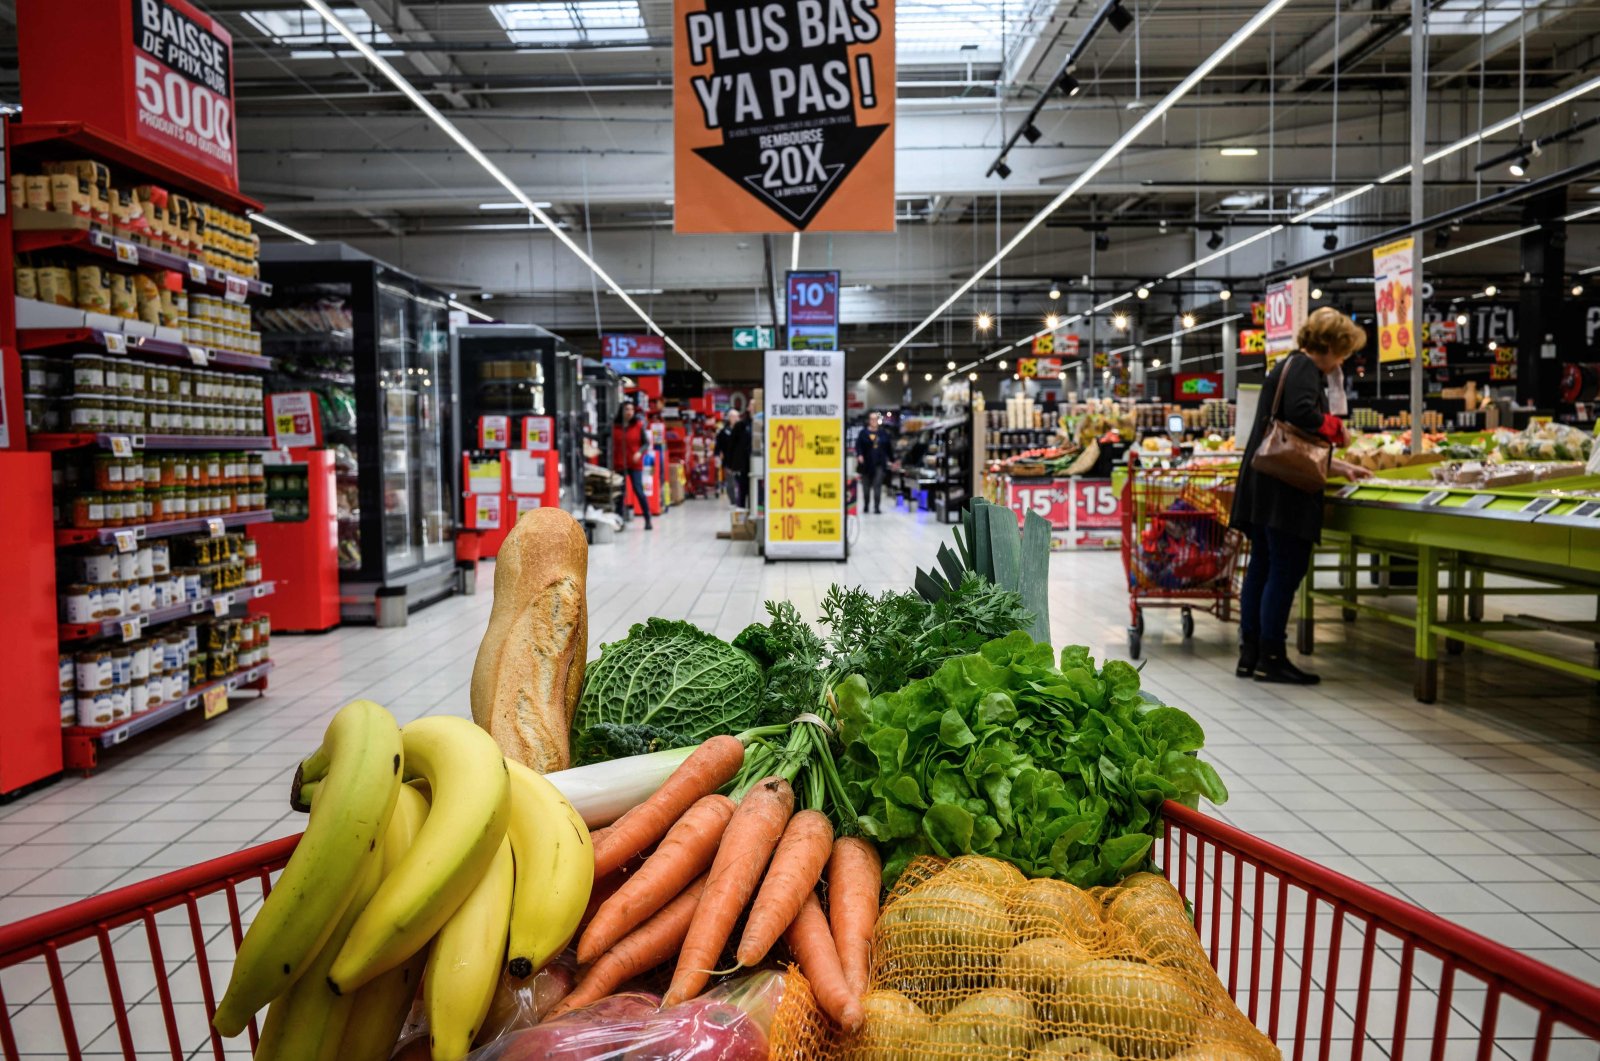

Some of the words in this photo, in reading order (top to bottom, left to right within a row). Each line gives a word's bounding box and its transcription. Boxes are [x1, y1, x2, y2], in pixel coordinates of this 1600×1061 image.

[142, 0, 225, 75] BAISSE
[688, 3, 789, 63] PLUS
[797, 0, 879, 48] BAS
[143, 31, 163, 59] DE
[168, 44, 202, 80] PRIX
[204, 63, 226, 95] SUR
[136, 55, 231, 150] 5000
[694, 72, 763, 127] Y'A
[770, 60, 850, 117] PAS
[139, 109, 184, 141] PRODUITS
[185, 130, 197, 147] DU
[760, 142, 828, 189] 20X
[791, 282, 835, 307] -10%
[605, 336, 637, 357] -15%
[782, 371, 828, 399] GLACES
[771, 424, 804, 465] -20%
[772, 475, 804, 508] -15%
[1012, 488, 1068, 517] -15%
[774, 514, 801, 540] -10%
